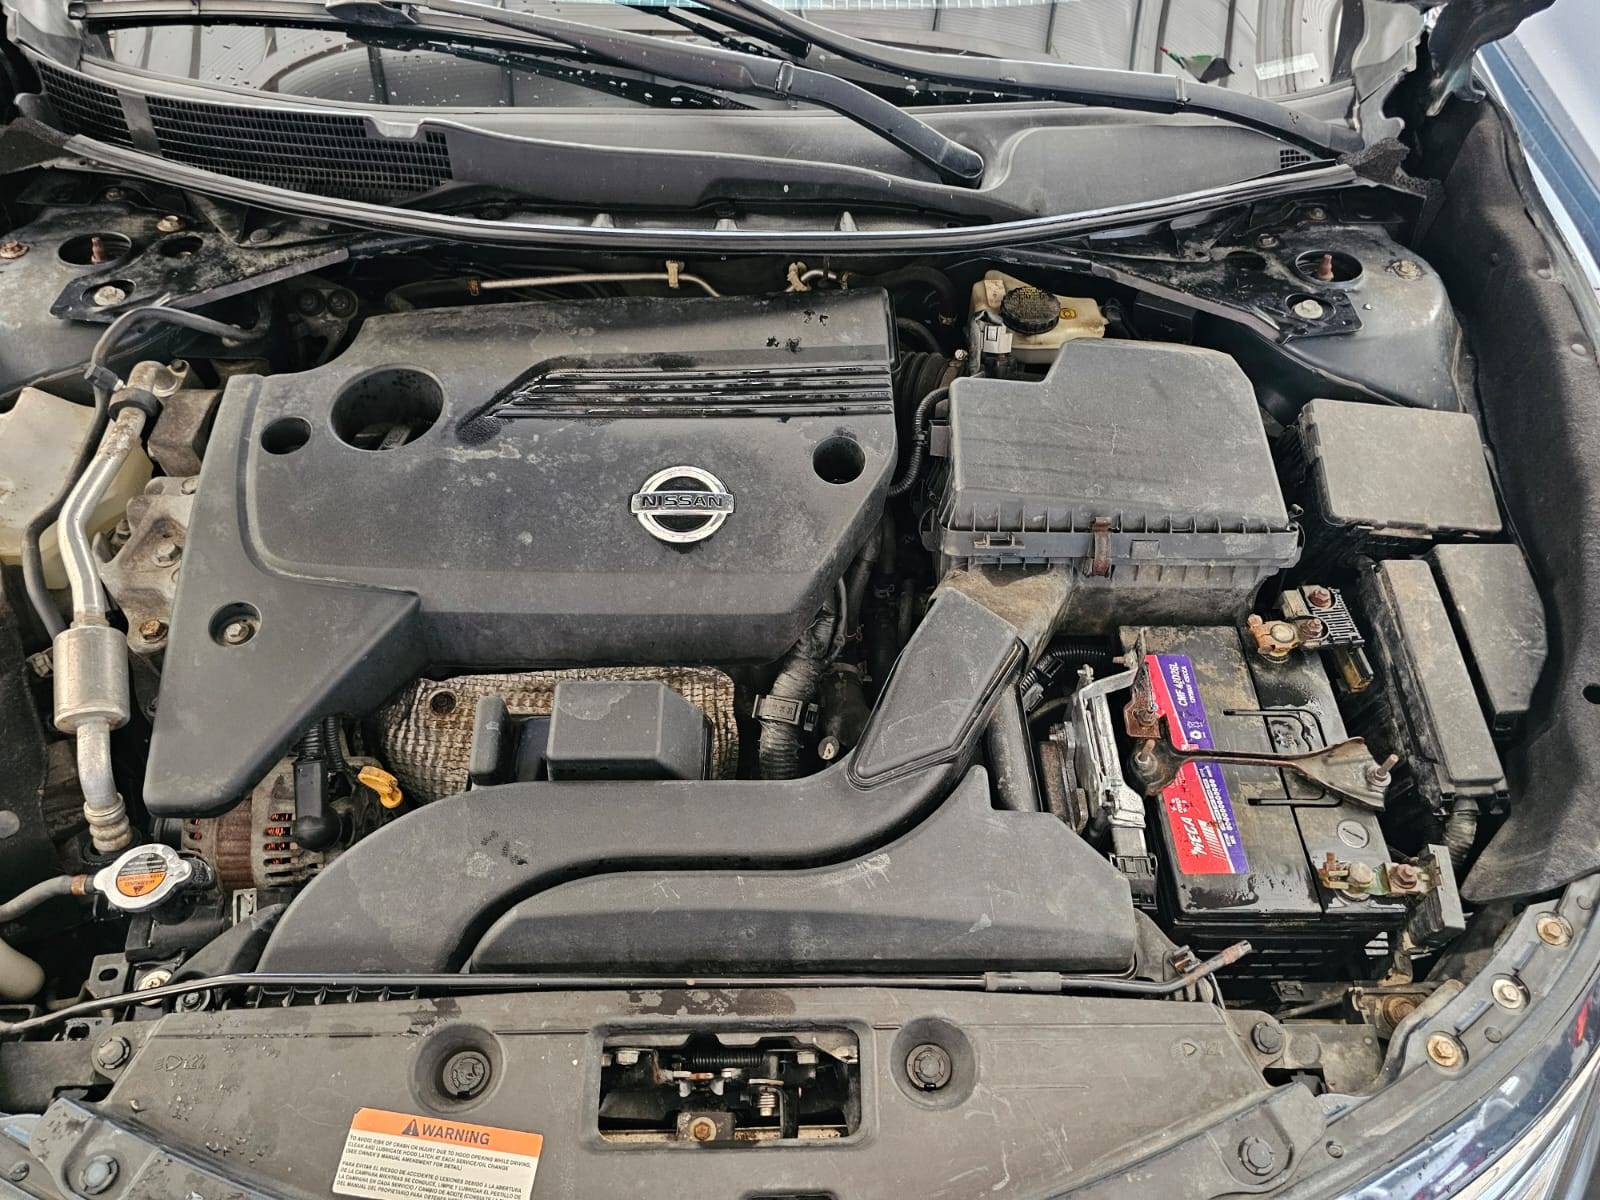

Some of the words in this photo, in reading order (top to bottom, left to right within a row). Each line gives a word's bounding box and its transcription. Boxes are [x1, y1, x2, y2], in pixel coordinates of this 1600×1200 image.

[642, 494, 723, 508] NISSAN
[1180, 816, 1207, 855] MEGA
[422, 1123, 490, 1145] WARNING
[380, 1153, 400, 1161] MANUAL
[488, 1163, 509, 1171] CHANGE
